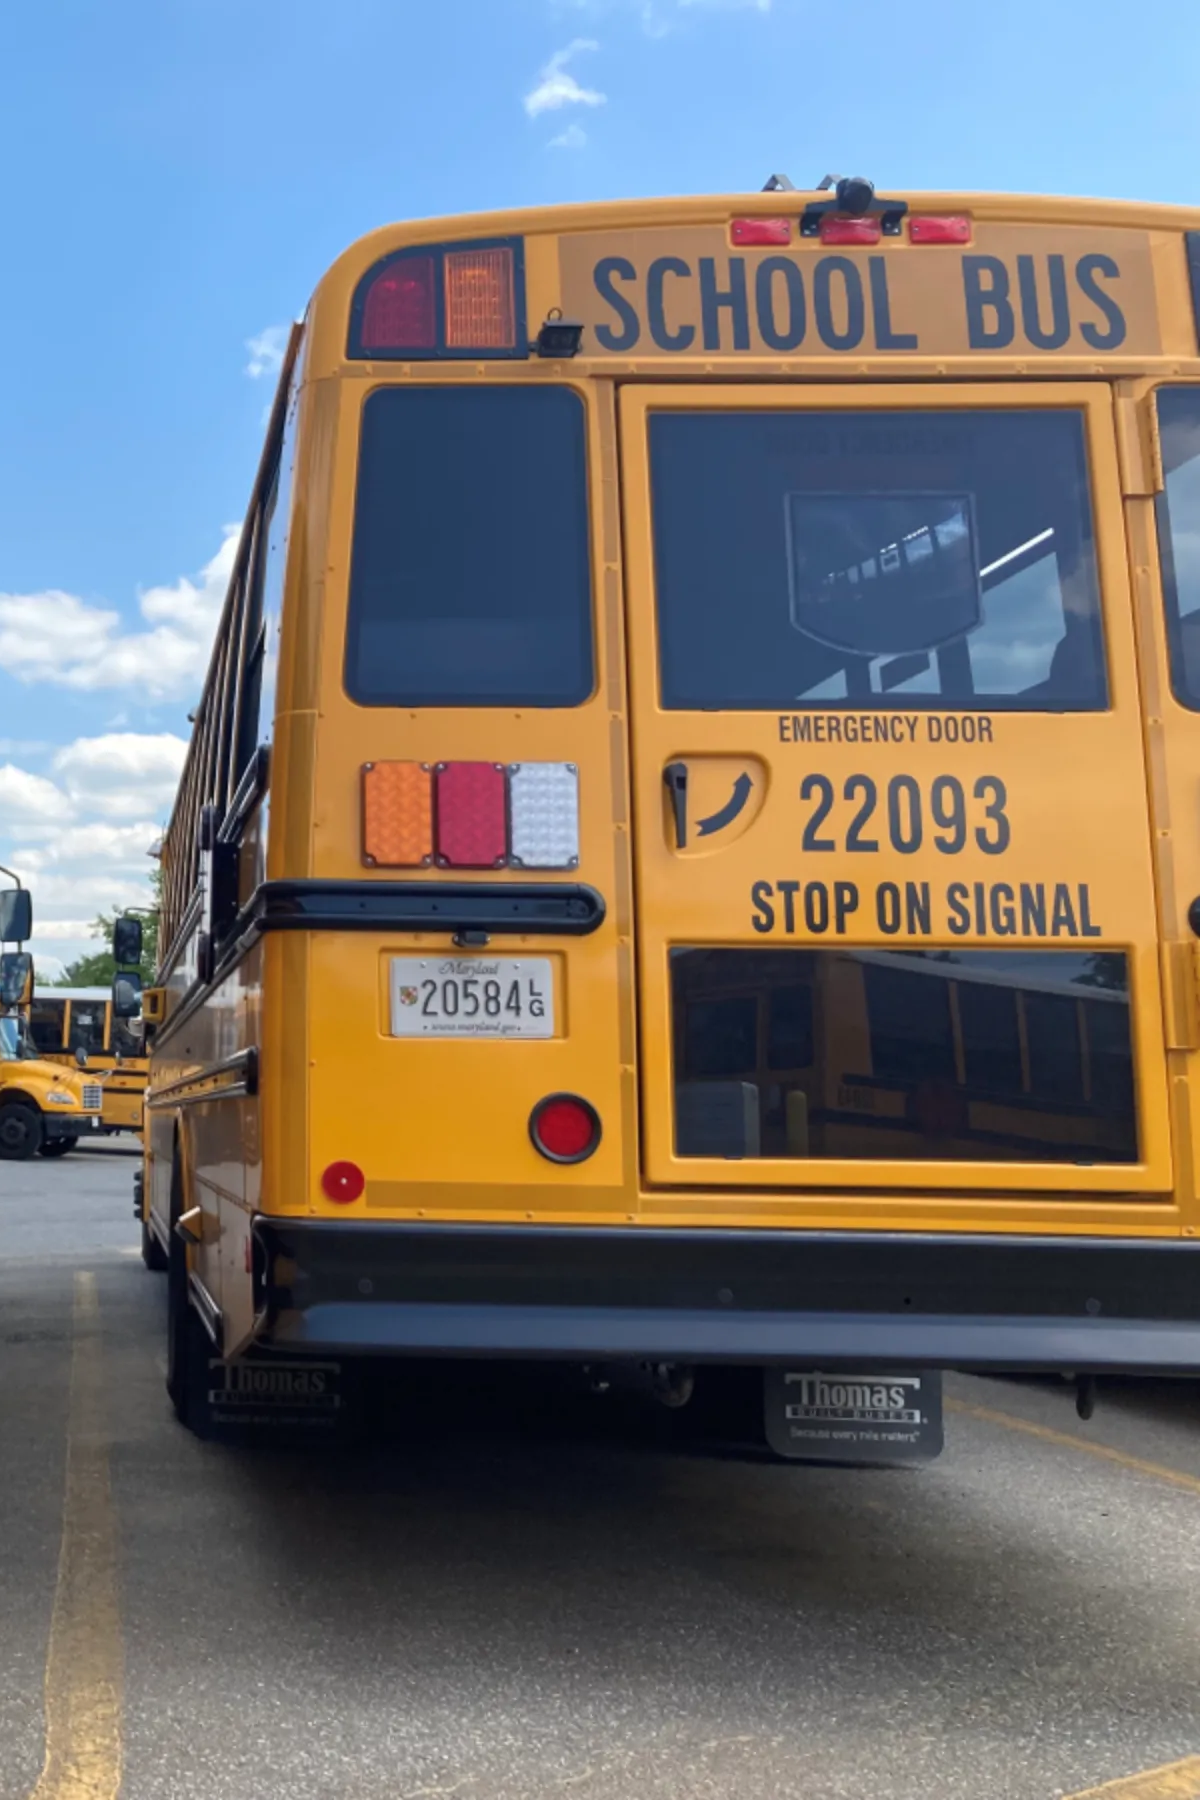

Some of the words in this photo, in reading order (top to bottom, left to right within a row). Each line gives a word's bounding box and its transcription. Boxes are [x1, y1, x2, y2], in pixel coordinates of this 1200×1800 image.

[592, 255, 918, 352] SCHOOL
[961, 253, 1127, 351] BUS
[779, 715, 918, 742] EMERGENCY
[927, 716, 994, 743] DOOR
[799, 773, 1011, 855] 22093
[750, 879, 860, 935] STOP
[875, 881, 932, 935] ON
[946, 882, 1102, 938] SIGNAL
[438, 961, 500, 978] Maryland
[420, 979, 522, 1018] 20584
[211, 1359, 336, 1393] Thomas
[786, 1371, 915, 1409] Thomas
